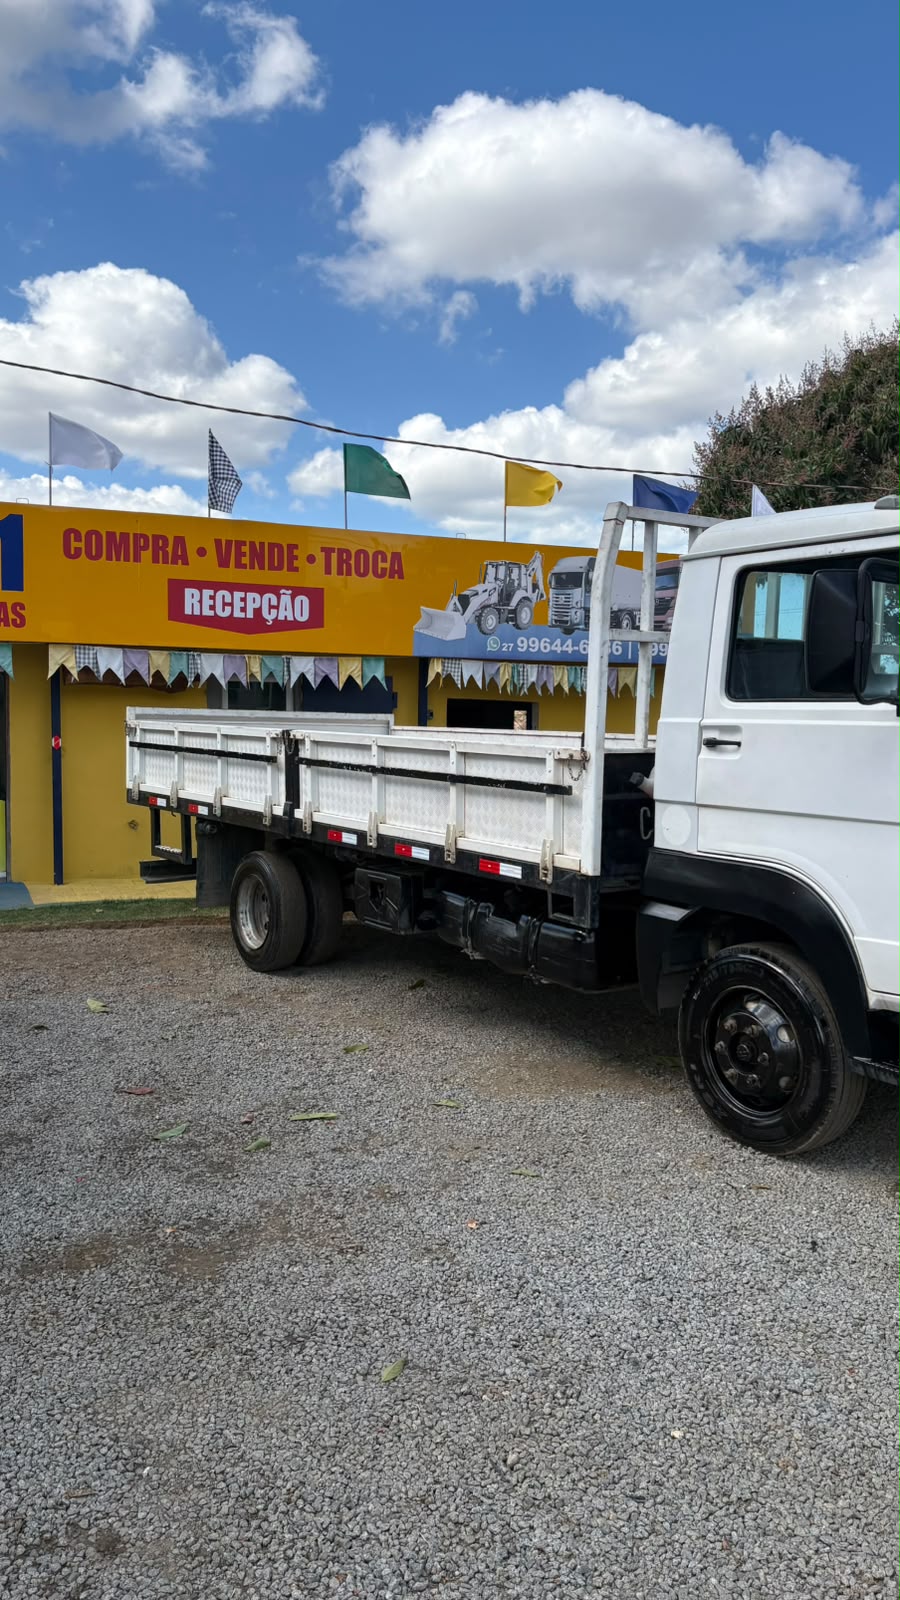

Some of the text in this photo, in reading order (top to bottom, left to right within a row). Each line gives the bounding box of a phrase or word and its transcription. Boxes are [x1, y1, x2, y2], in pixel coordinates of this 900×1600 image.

[63, 528, 405, 580] COMPRA VENDE TROCA
[184, 588, 310, 625] RECEPÇÃO
[502, 642, 514, 652] 27
[517, 637, 622, 656] 99644-66
